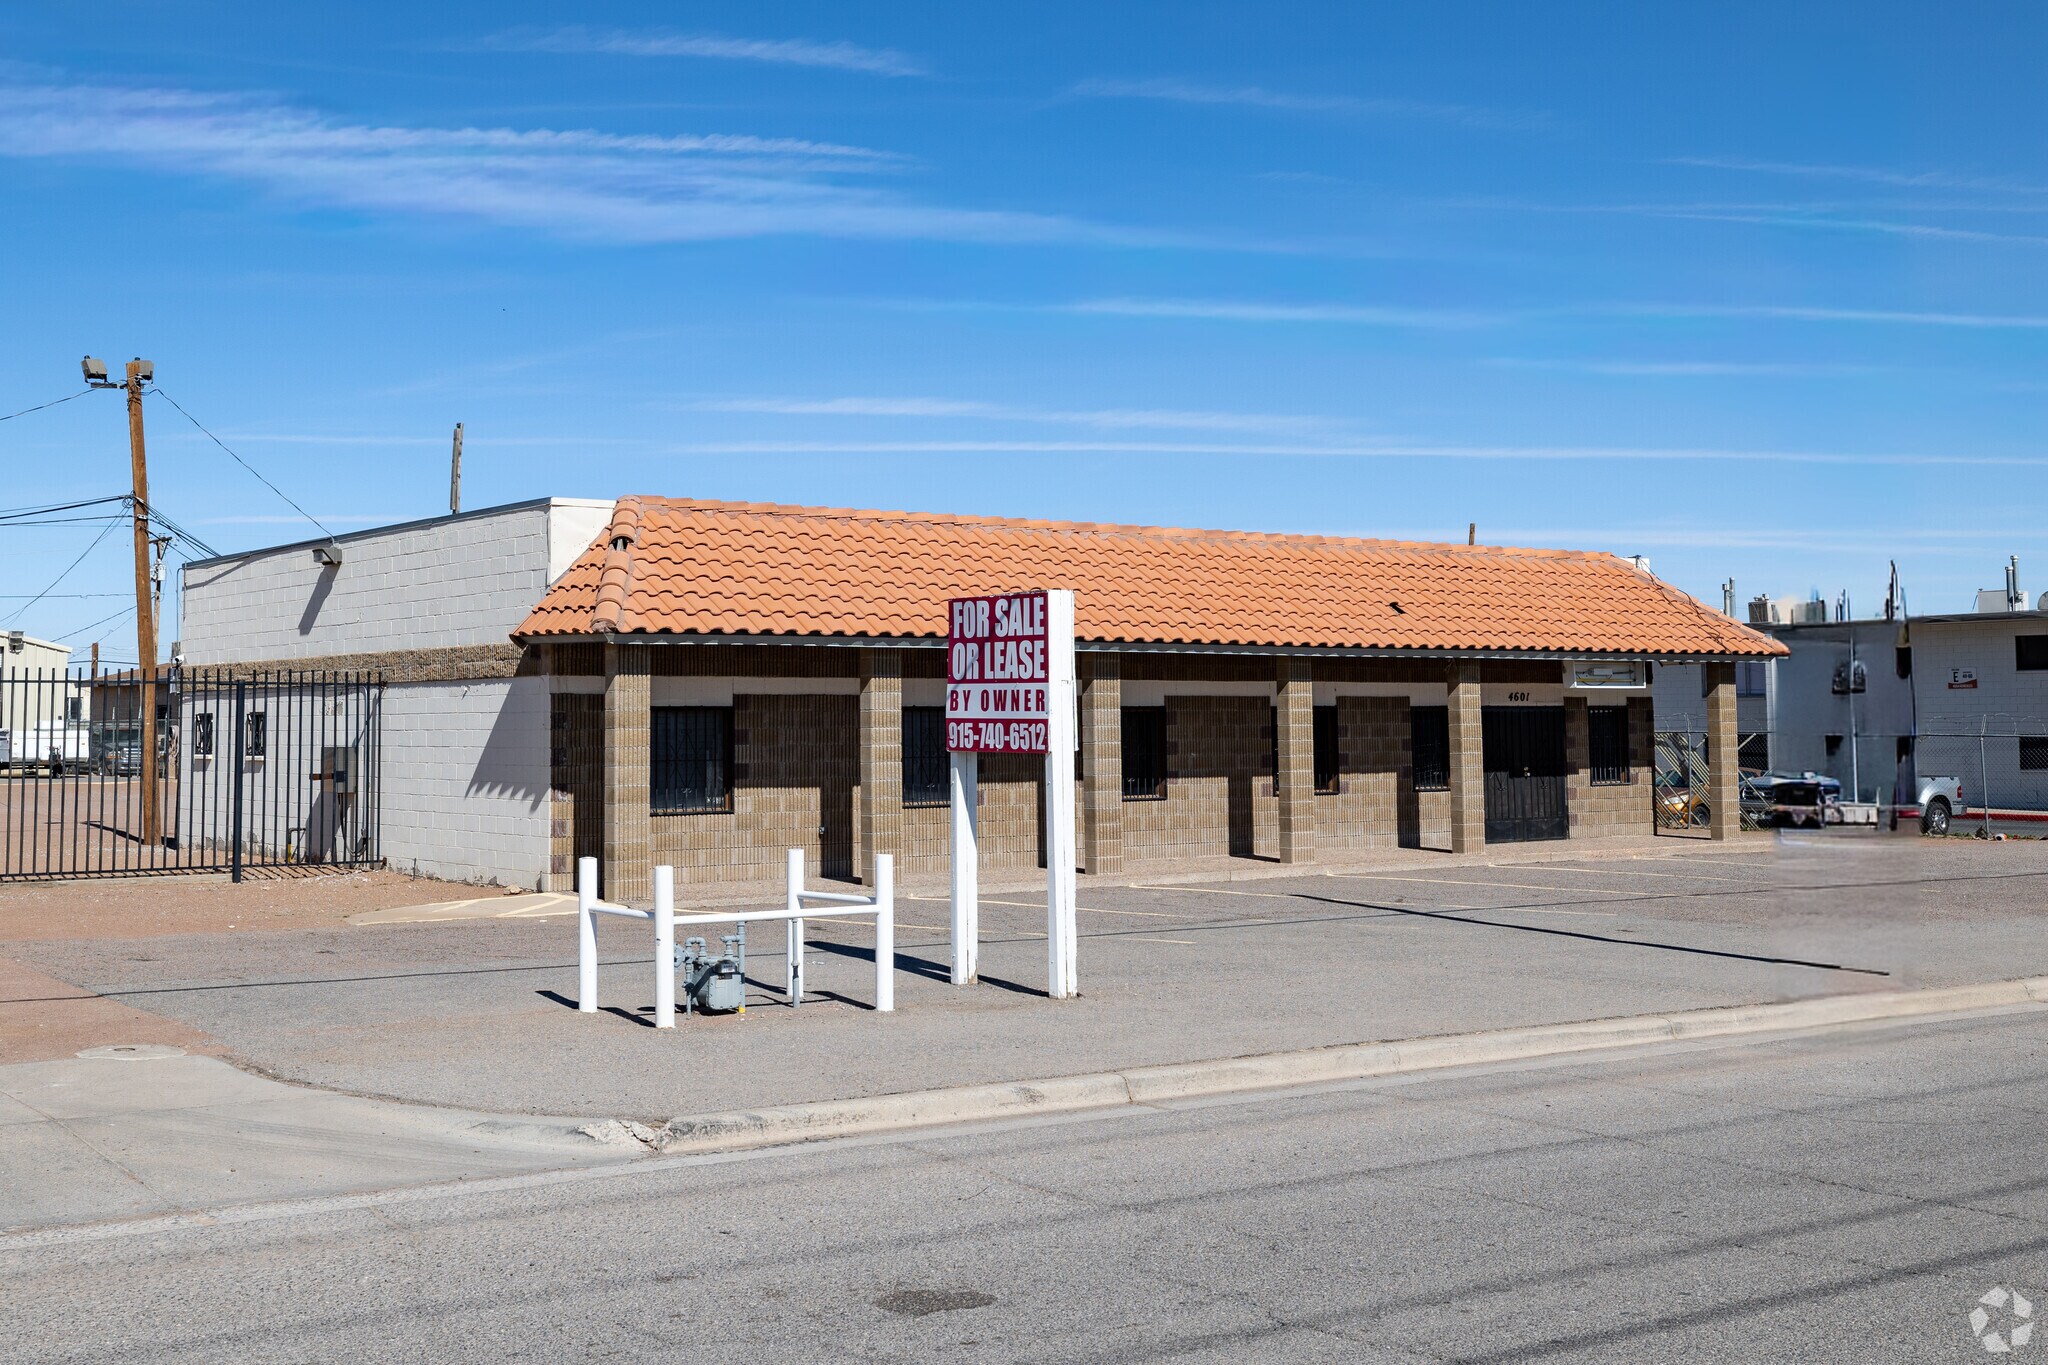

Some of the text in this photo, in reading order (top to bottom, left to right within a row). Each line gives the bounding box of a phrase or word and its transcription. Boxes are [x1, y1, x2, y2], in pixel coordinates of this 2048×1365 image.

[953, 597, 1044, 638] FOR SALE
[953, 640, 1045, 680] OR LEASE
[1953, 672, 1959, 682] E
[950, 689, 1045, 712] BY OWNER
[1508, 691, 1530, 702] 4601
[949, 722, 1045, 750] 915-740-6512
